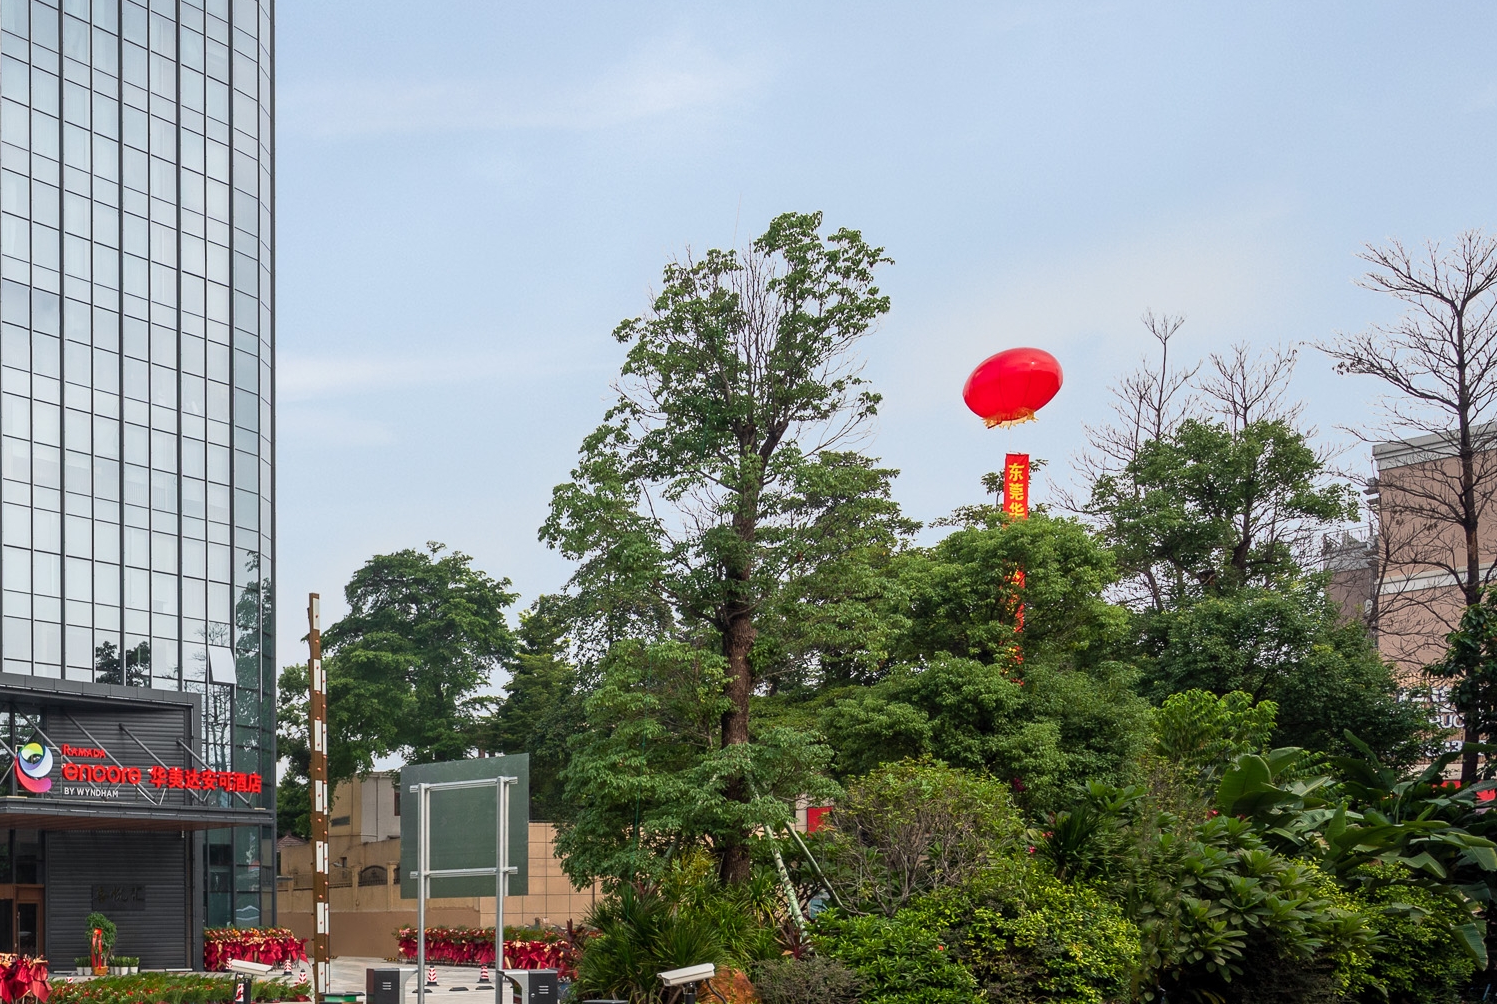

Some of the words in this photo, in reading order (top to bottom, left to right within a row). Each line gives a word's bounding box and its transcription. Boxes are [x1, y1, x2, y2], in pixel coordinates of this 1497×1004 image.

[61, 743, 106, 758] RAMADA
[62, 763, 142, 785] encore
[149, 765, 262, 793] 华美达安可酒店
[64, 787, 76, 795] BY
[77, 787, 119, 798] WYNDHAM
